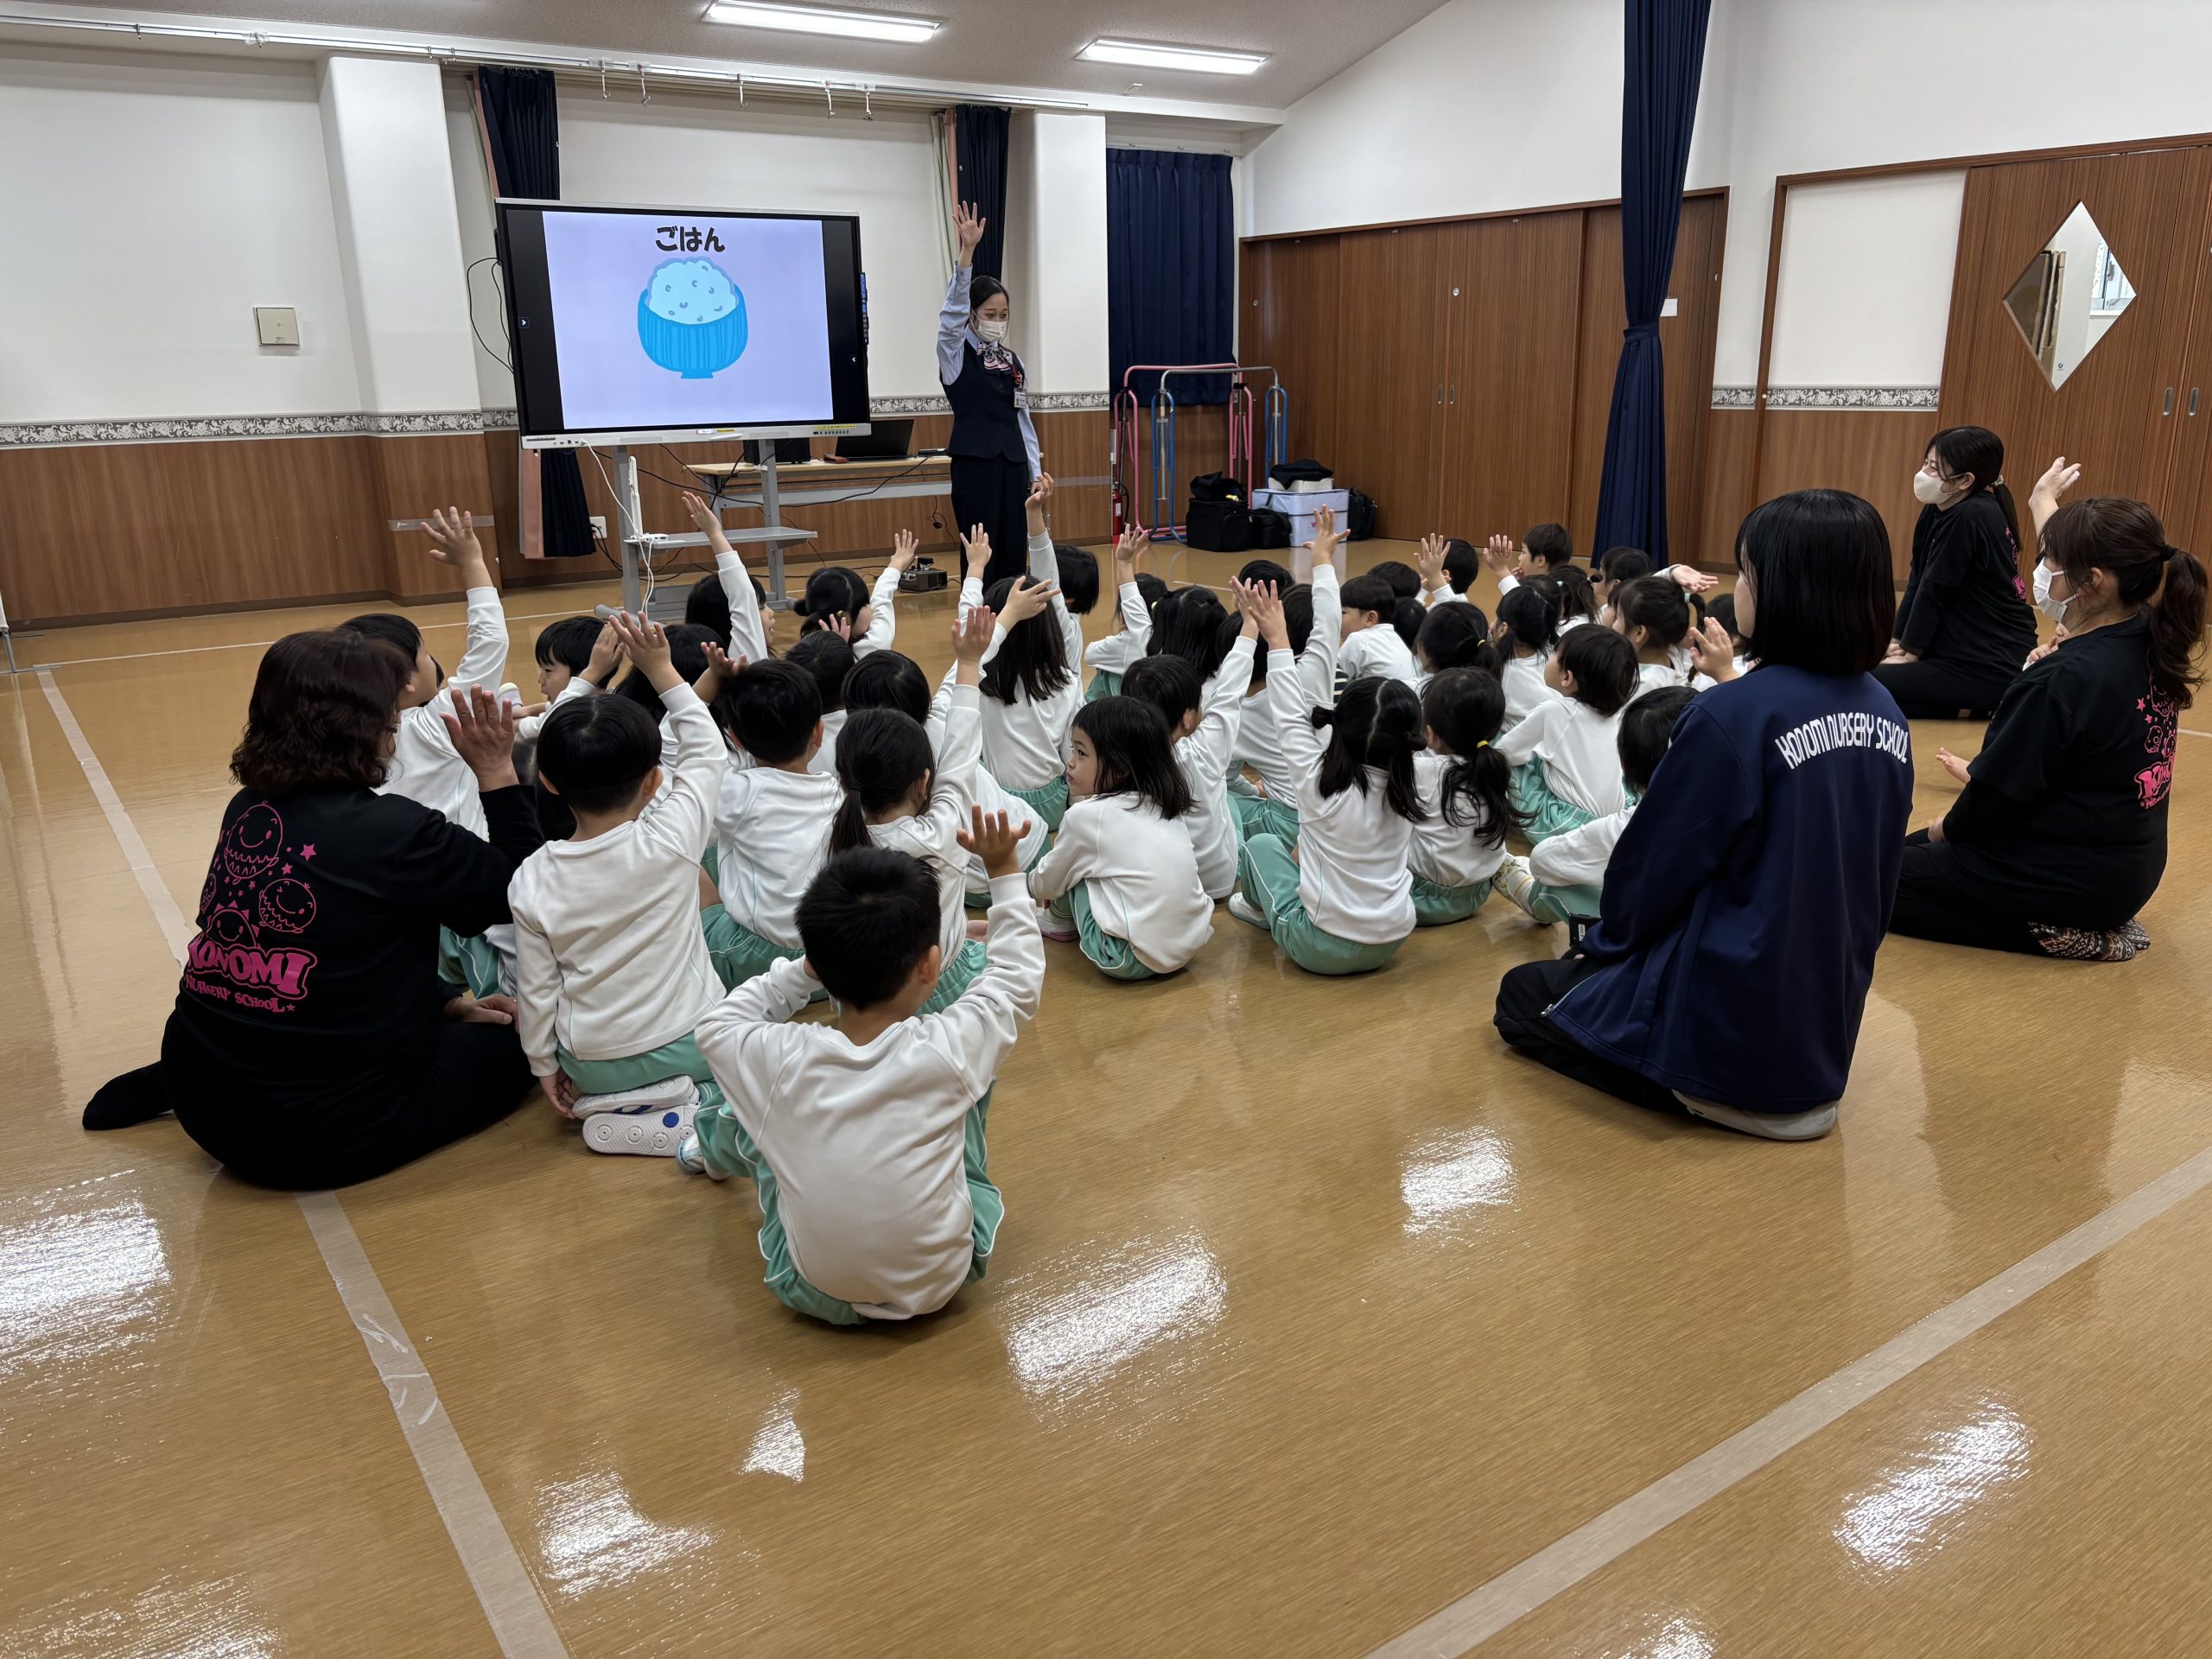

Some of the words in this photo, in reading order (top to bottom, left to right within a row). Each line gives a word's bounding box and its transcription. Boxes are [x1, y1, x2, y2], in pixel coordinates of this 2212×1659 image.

[655, 225, 726, 252] ごはん
[1774, 716, 1830, 770] KONOMI
[1826, 712, 1874, 749] NURSERY
[1875, 716, 1909, 764] SCHOOL
[235, 991, 286, 1014] SCHOOL
